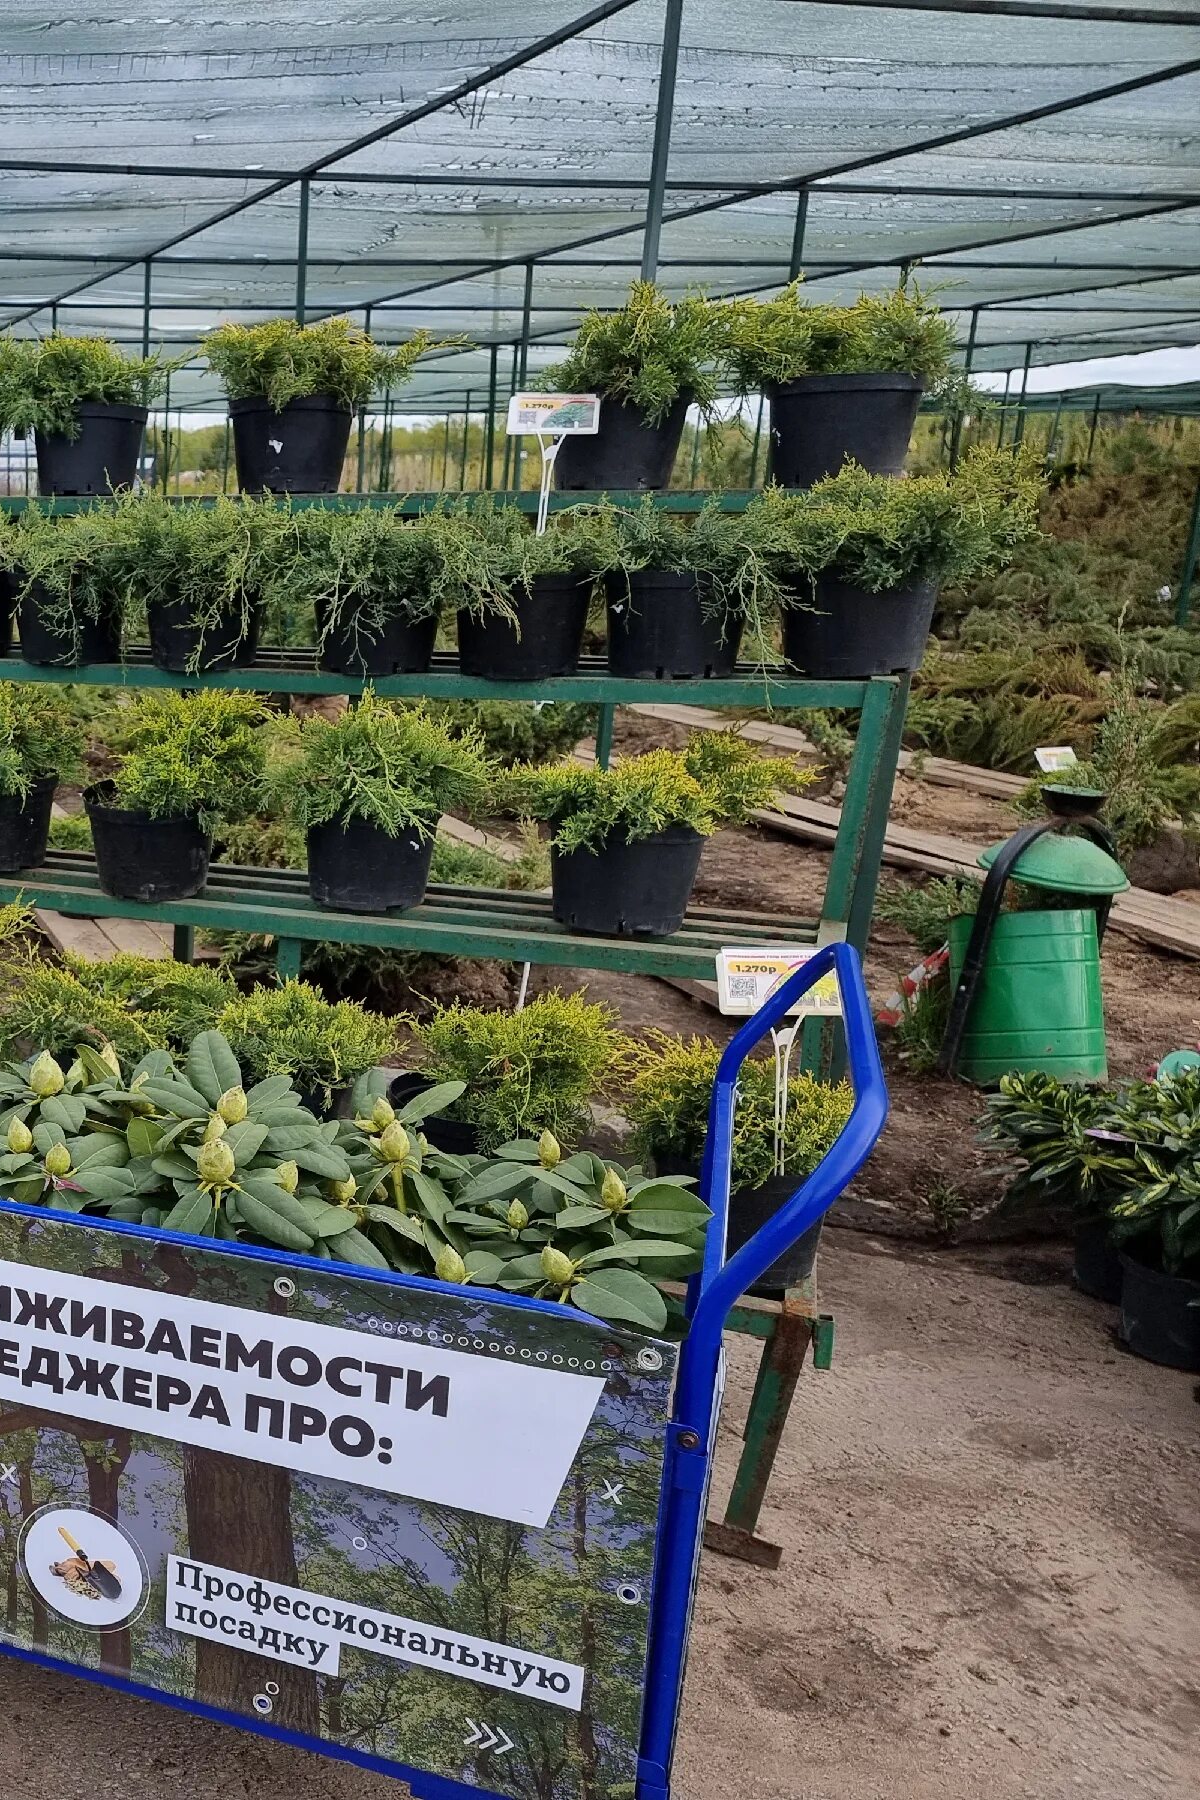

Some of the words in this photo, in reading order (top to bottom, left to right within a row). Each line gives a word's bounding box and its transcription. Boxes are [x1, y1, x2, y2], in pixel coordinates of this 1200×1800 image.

[735, 964, 777, 975] 1.270р
[245, 1393, 394, 1465] ПРО:
[175, 1602, 330, 1666] посадку
[176, 1561, 570, 1695] Профессиональную
